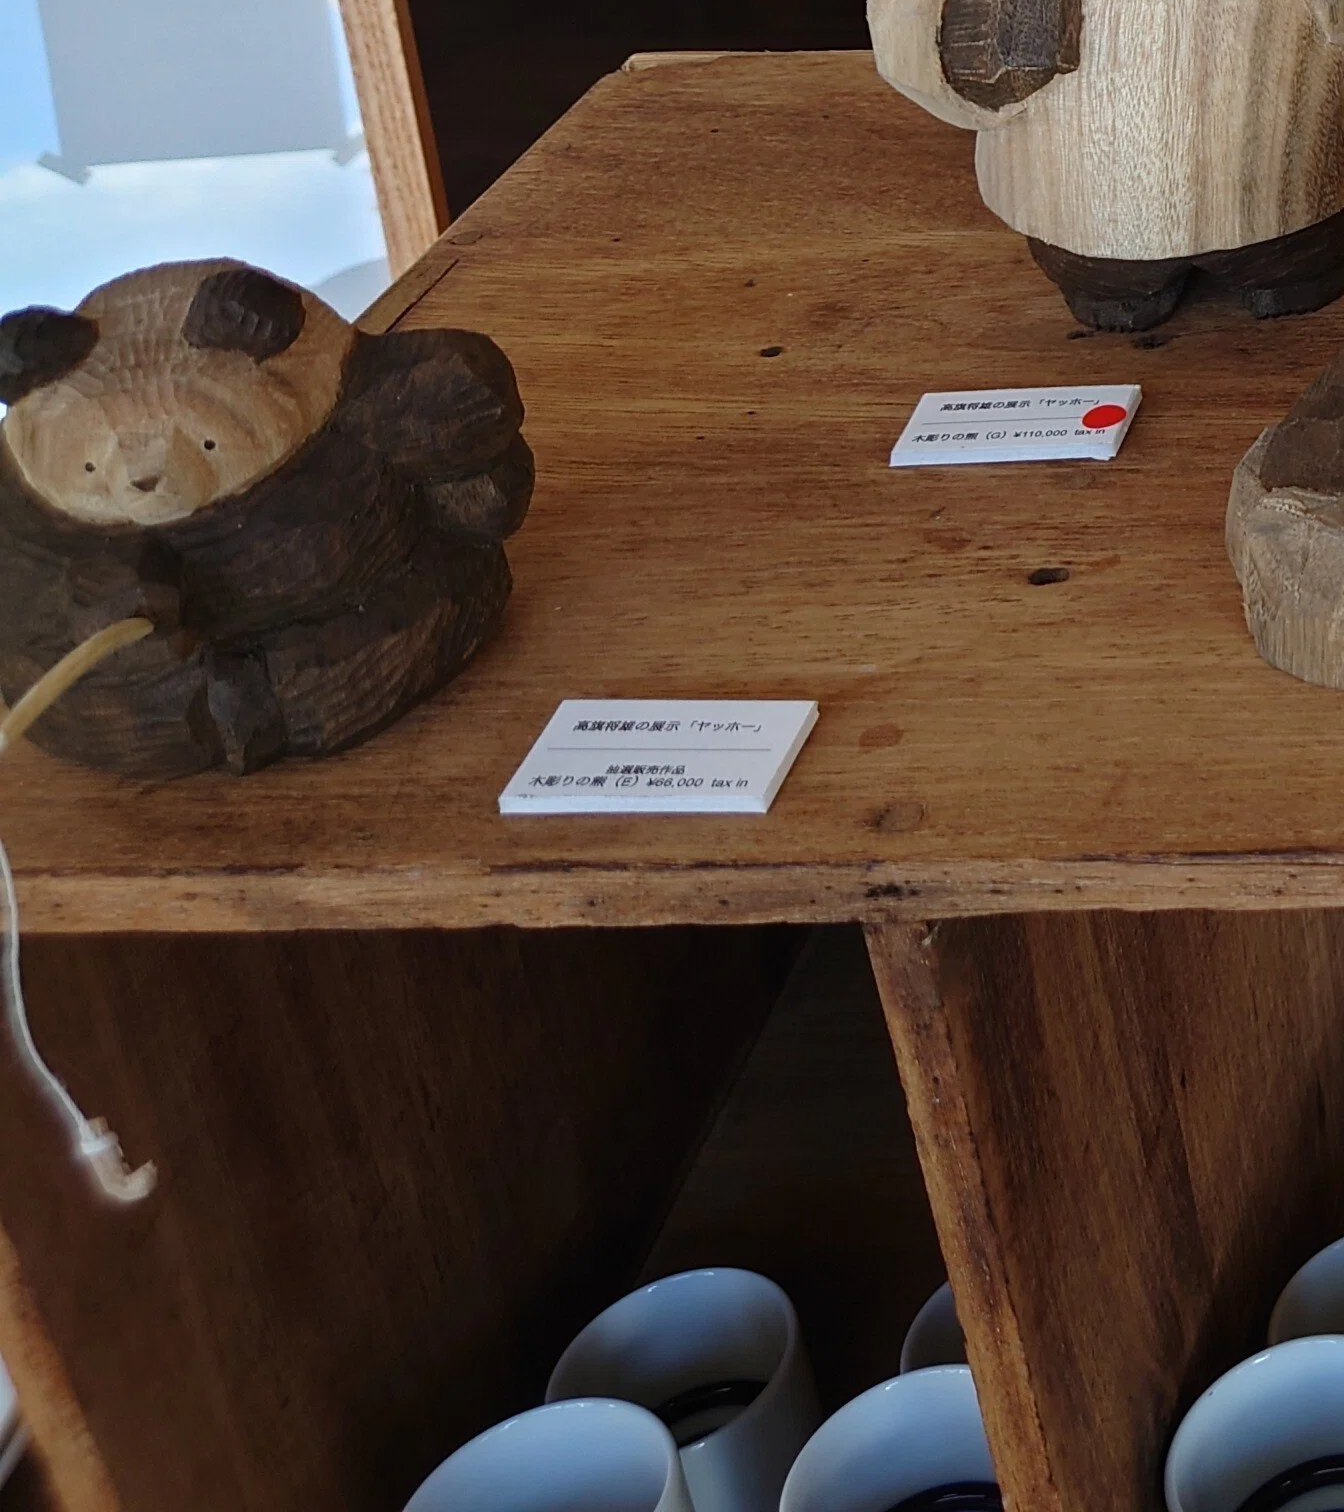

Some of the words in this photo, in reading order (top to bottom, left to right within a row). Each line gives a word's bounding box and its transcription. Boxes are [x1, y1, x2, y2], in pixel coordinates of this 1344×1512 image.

[940, 397, 1101, 412] 高旗将雄の展示「ヤッホー」
[573, 719, 763, 733] 高旗将雄の展示「ヤッホー」
[605, 764, 686, 775] 抽選販売作品
[710, 778, 733, 787] tax
[736, 777, 749, 787] in
